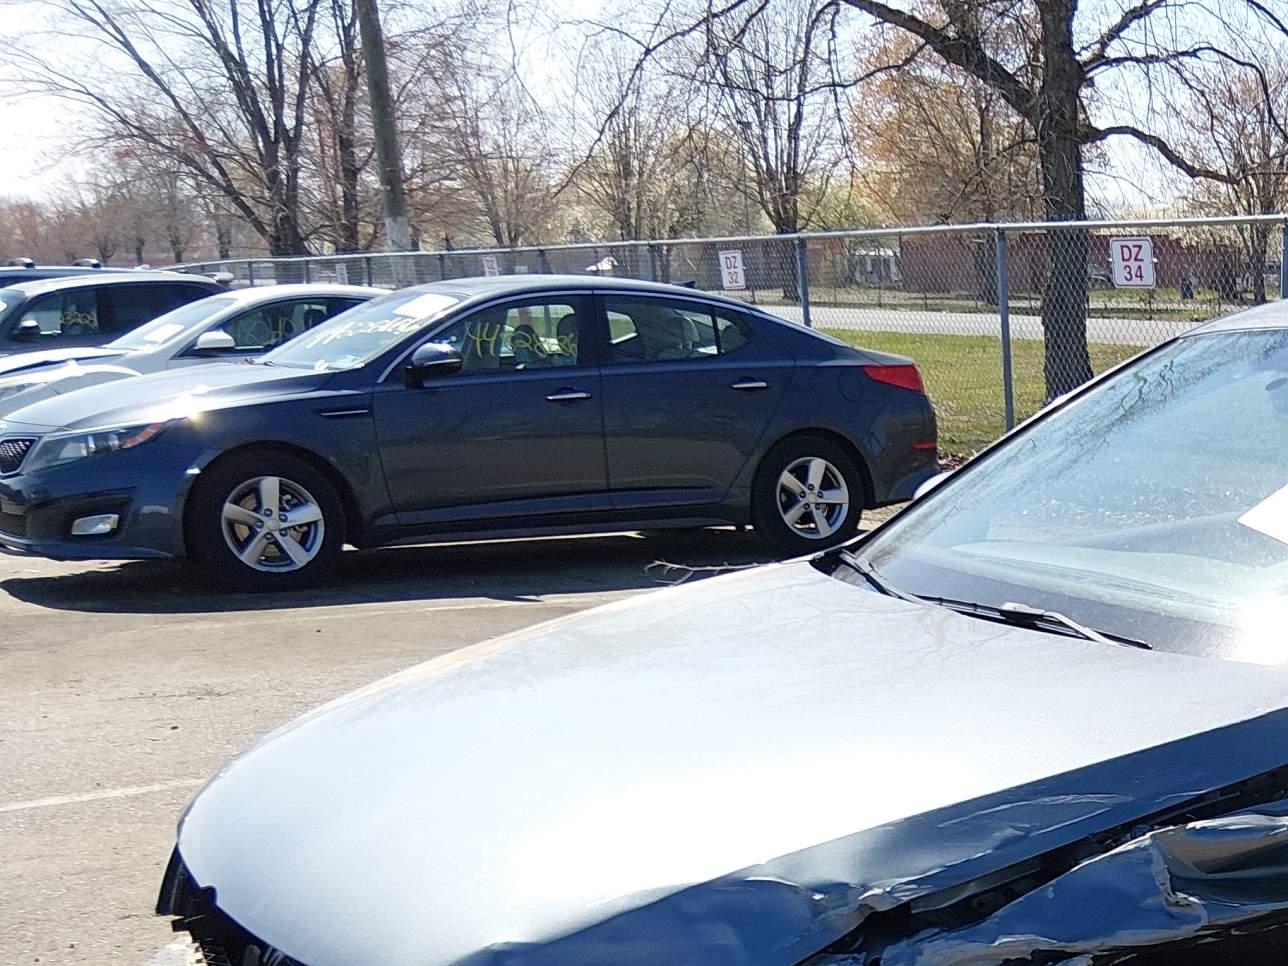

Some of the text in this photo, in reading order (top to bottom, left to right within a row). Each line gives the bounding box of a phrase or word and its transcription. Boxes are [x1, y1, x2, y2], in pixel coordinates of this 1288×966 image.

[1120, 244, 1145, 262] DZ
[724, 255, 738, 270] DZ
[728, 271, 740, 284] 32
[1123, 264, 1144, 282] 34
